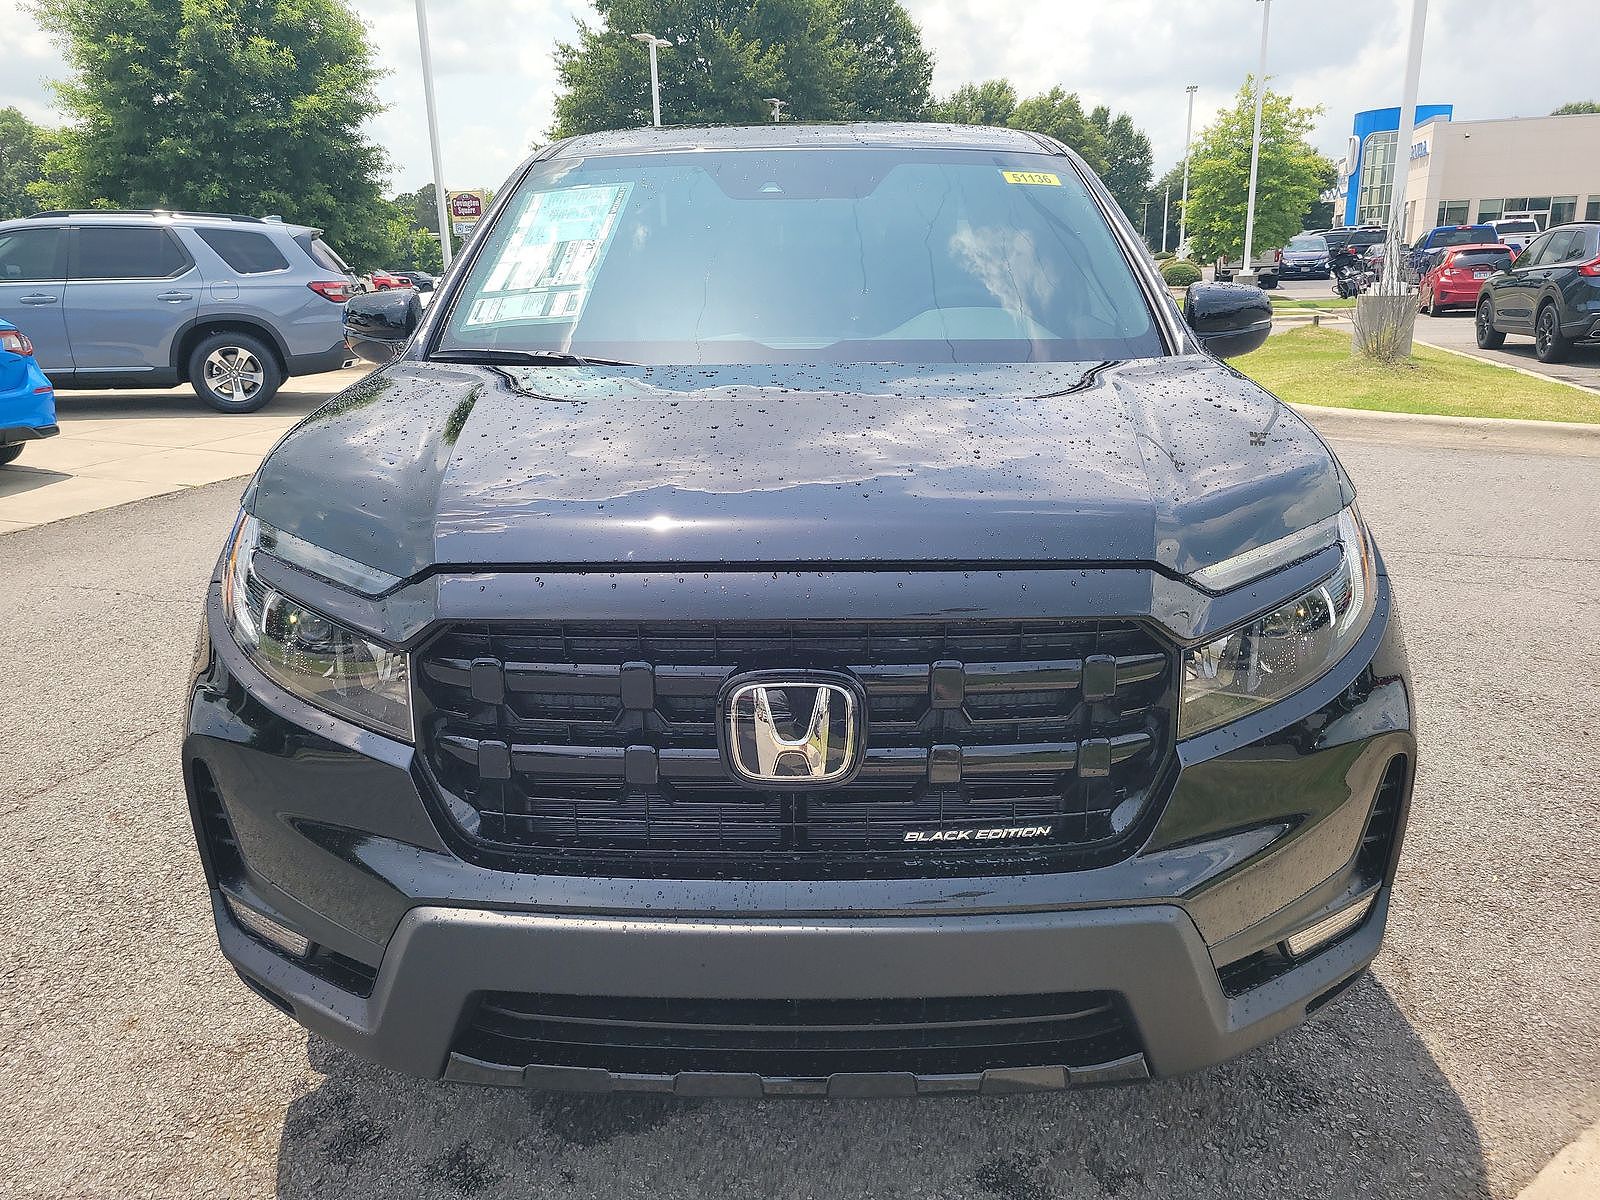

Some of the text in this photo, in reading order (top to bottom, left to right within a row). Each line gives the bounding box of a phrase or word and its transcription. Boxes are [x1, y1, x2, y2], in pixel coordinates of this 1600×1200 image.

[1012, 173, 1052, 184] 51136
[453, 199, 480, 208] Covington
[457, 207, 476, 215] Square
[903, 826, 1052, 842] BLACK EDITION
